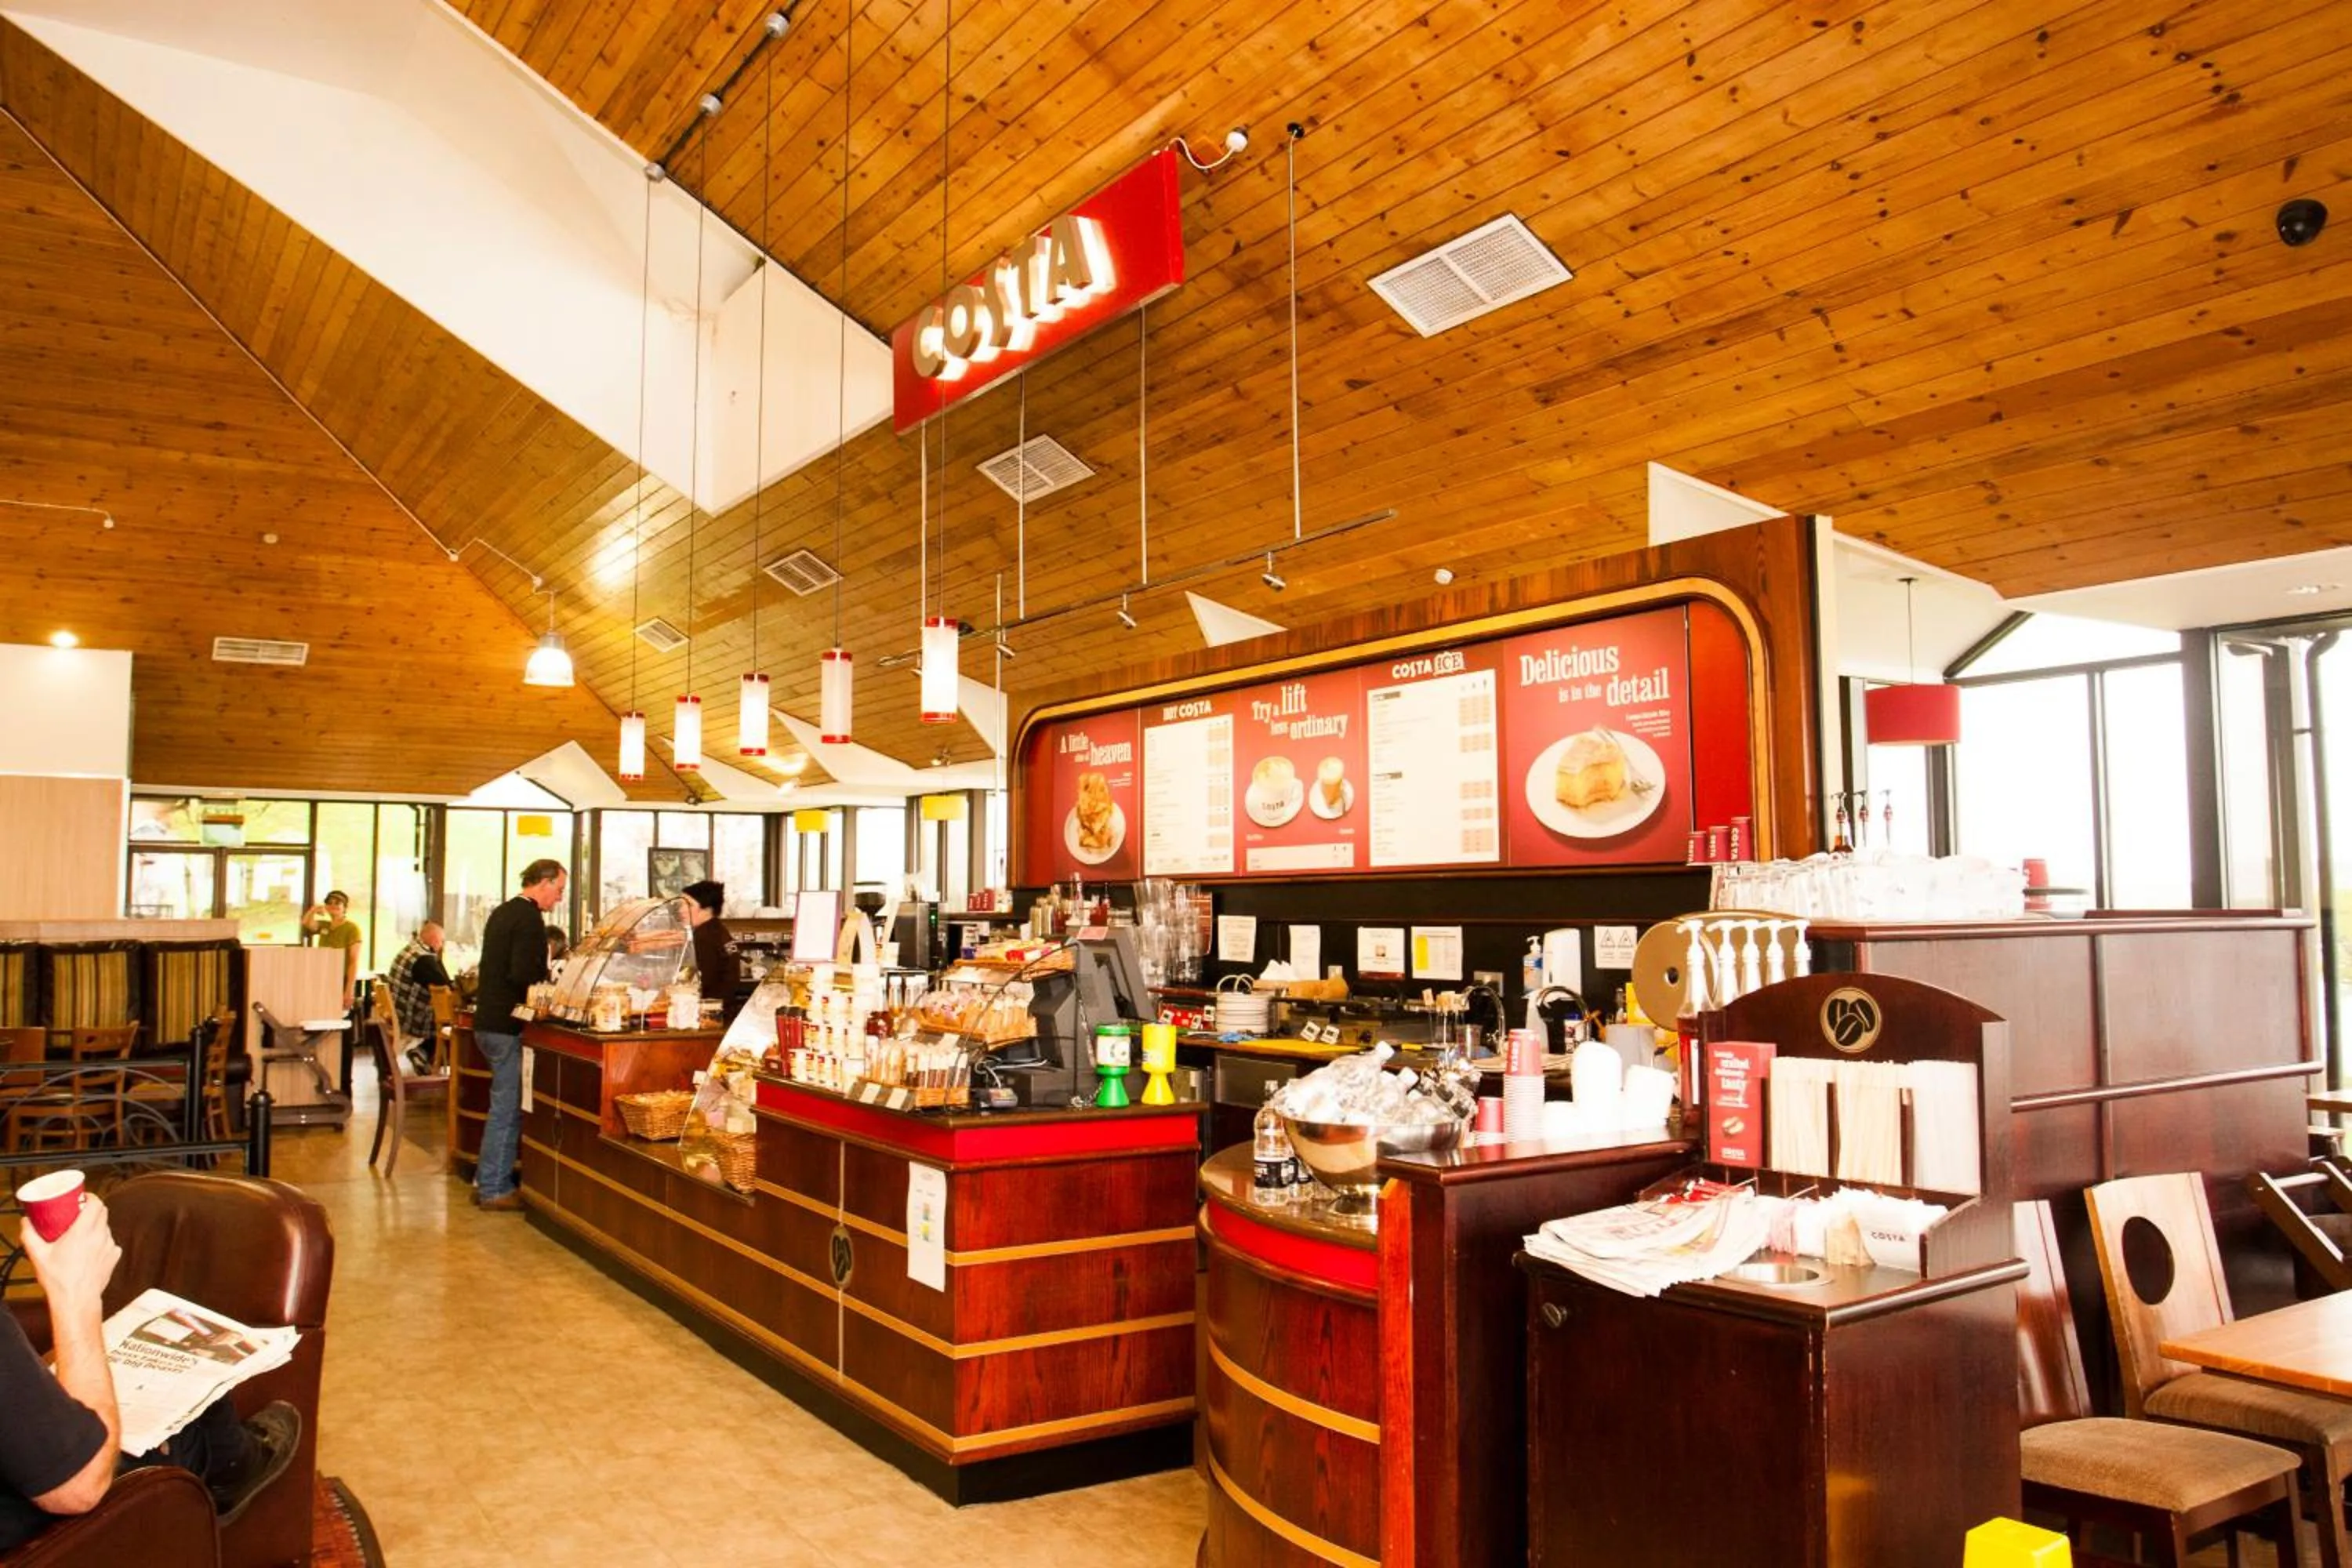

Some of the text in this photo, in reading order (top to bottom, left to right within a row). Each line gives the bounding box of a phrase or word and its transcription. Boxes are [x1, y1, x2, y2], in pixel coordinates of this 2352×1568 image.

[913, 214, 1093, 377] COSTA
[1392, 652, 1463, 679] COSTA ICE
[1519, 646, 1620, 687] Delicious
[1606, 666, 1670, 706] detail
[1178, 700, 1212, 717] COSTA
[1252, 701, 1272, 724] Try
[1281, 684, 1307, 715] lift
[1290, 714, 1348, 740] ordinary
[1059, 735, 1067, 753] A
[1090, 742, 1132, 767] heaven
[1731, 827, 1740, 860] COSTA
[1871, 1231, 1906, 1242] COSTA
[119, 1339, 199, 1364] Nationwide's
